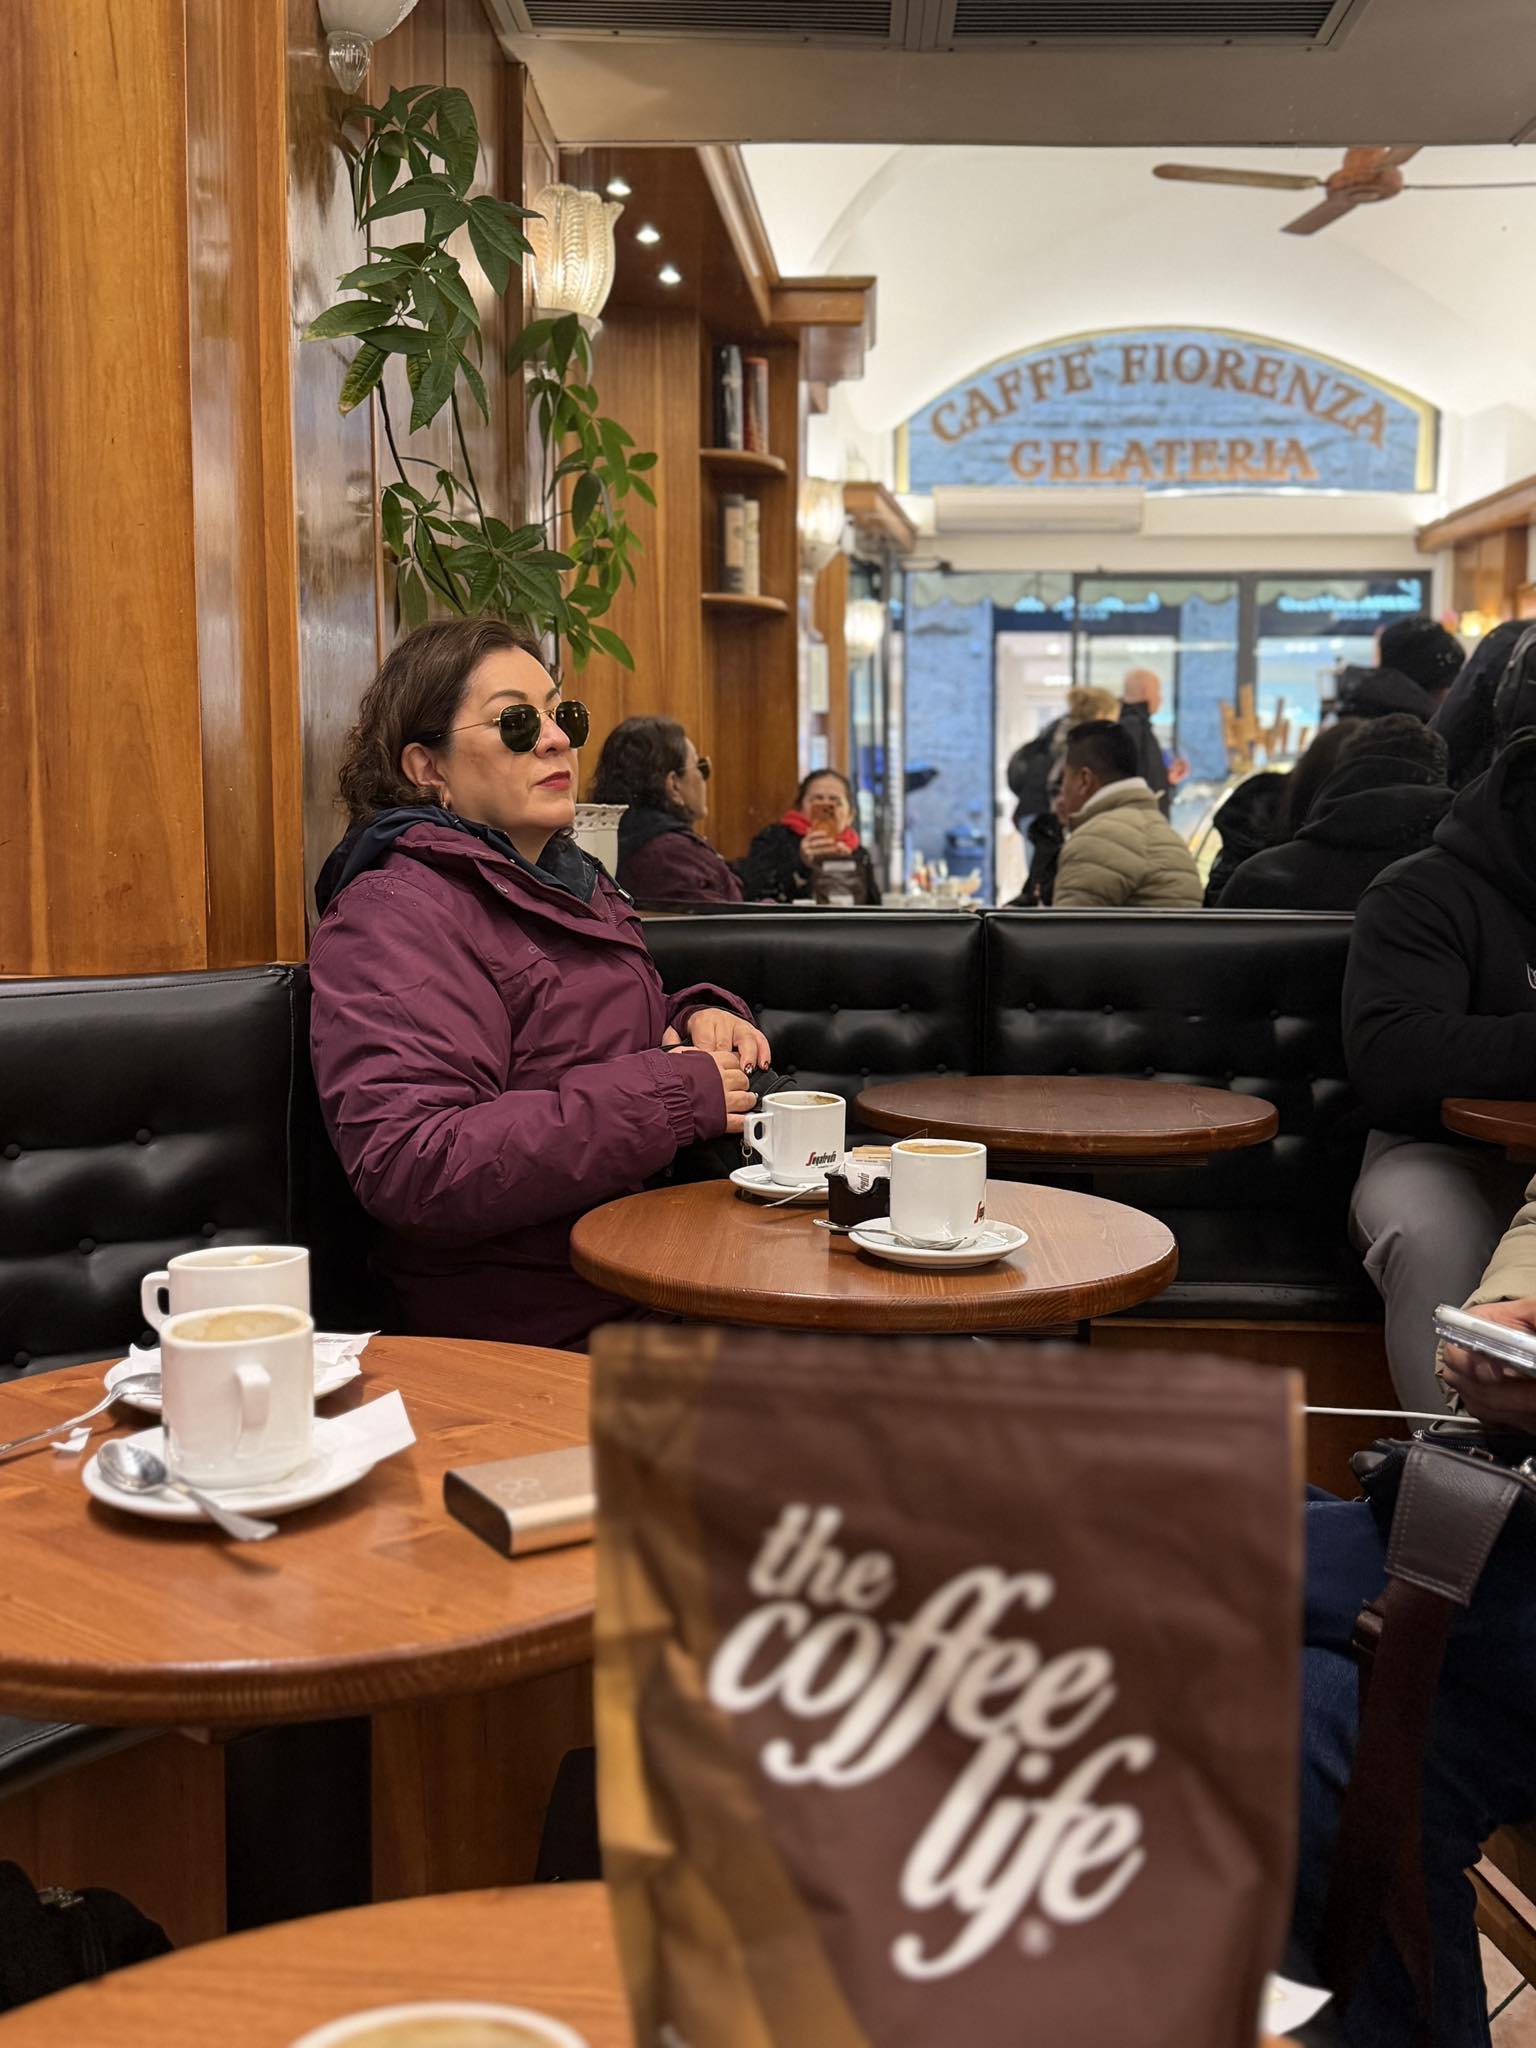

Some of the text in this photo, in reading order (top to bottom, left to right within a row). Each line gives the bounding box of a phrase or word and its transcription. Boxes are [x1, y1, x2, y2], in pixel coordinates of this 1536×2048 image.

[1120, 343, 1388, 448] FIORENZA
[1010, 438, 1320, 483] GELATERIA
[747, 1502, 896, 1611] the
[707, 1566, 1118, 1789] coffee
[892, 1732, 1156, 1981] life
